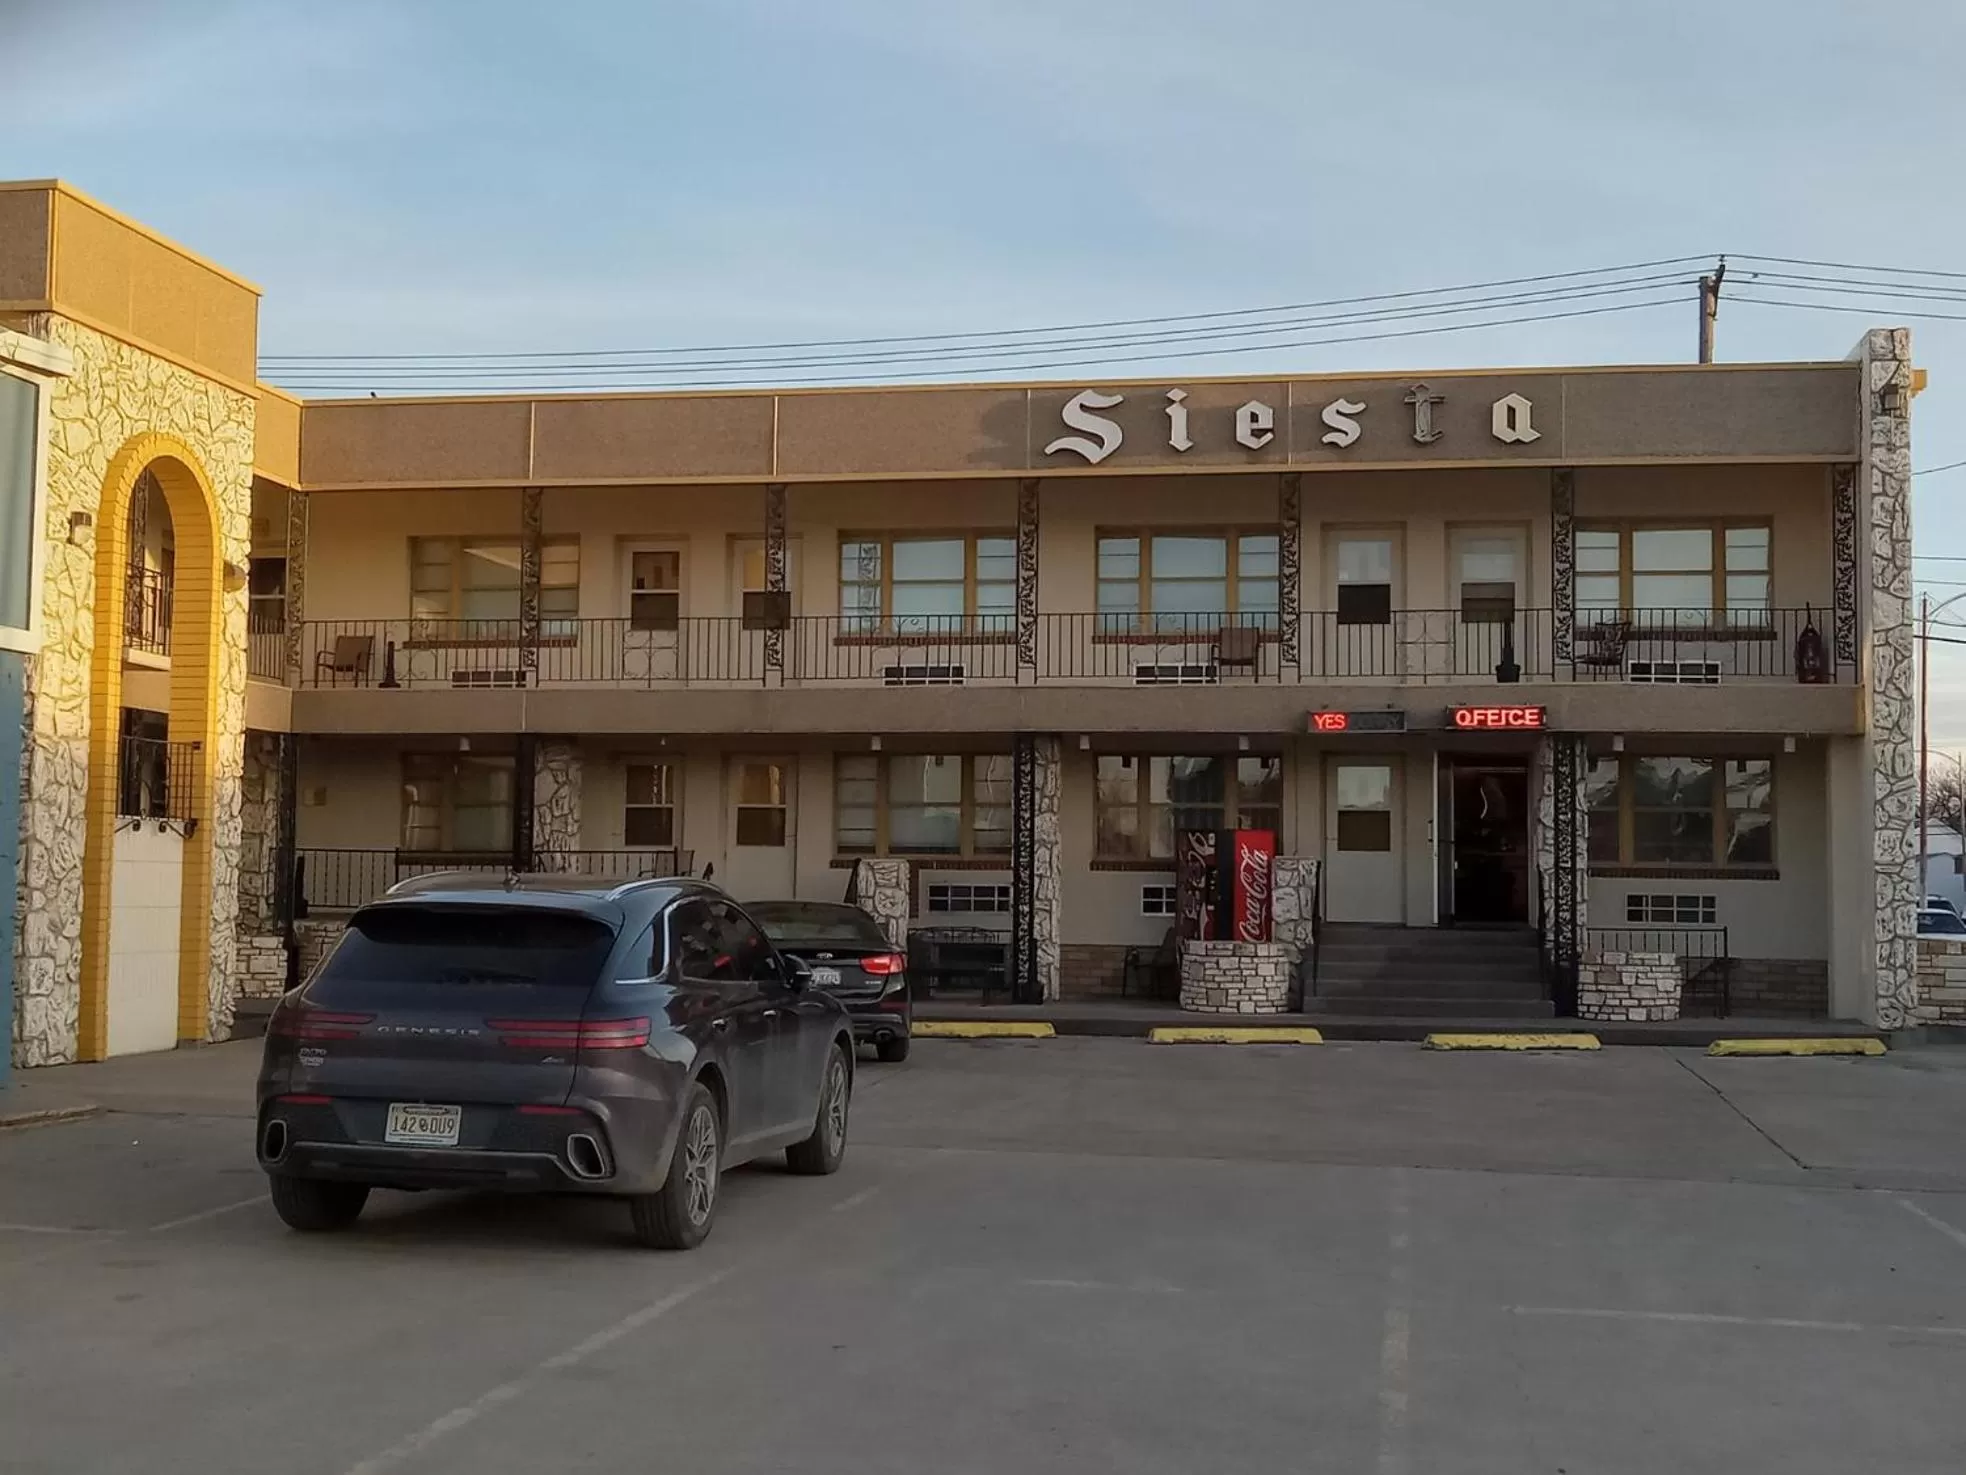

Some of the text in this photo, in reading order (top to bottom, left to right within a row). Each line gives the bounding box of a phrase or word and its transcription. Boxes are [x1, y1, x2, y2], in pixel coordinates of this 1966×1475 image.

[1044, 383, 1541, 464] Siesta
[1313, 714, 1346, 729] YES
[1239, 843, 1268, 943] Coca-Cola
[377, 1026, 480, 1035] GENESIS
